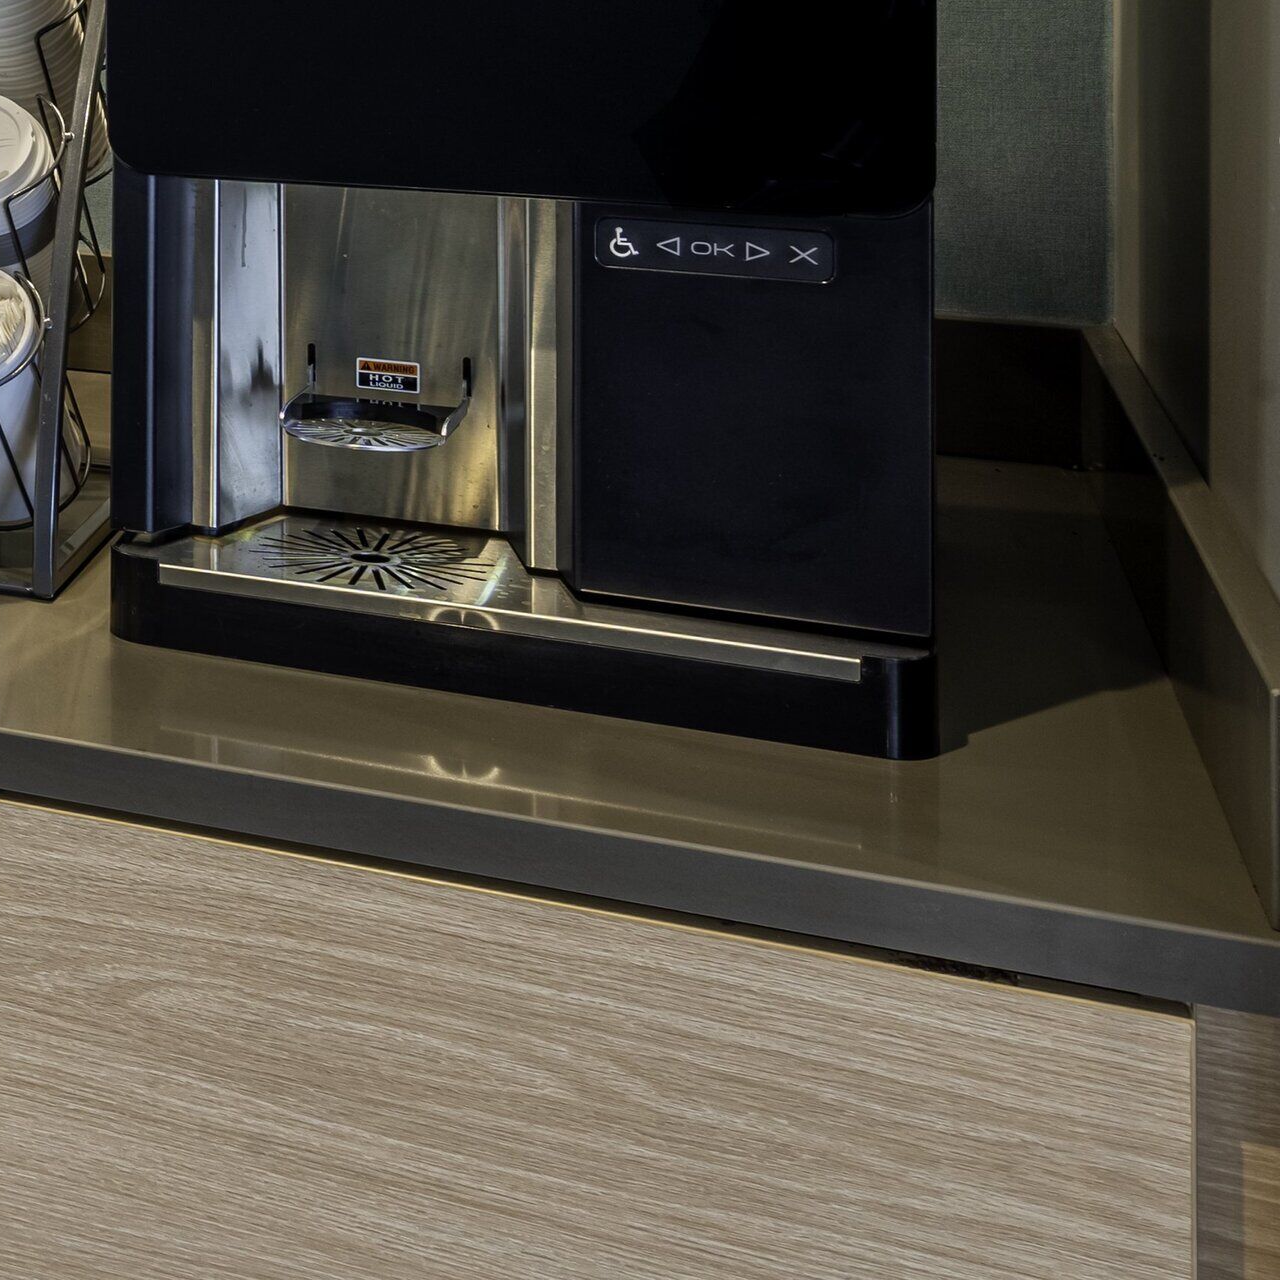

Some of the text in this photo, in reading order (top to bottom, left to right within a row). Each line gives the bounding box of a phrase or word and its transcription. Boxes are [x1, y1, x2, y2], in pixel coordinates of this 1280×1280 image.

[690, 241, 735, 258] OK
[373, 362, 415, 374] WARNING
[369, 374, 405, 384] HOT
[369, 381, 404, 390] LIQUID
